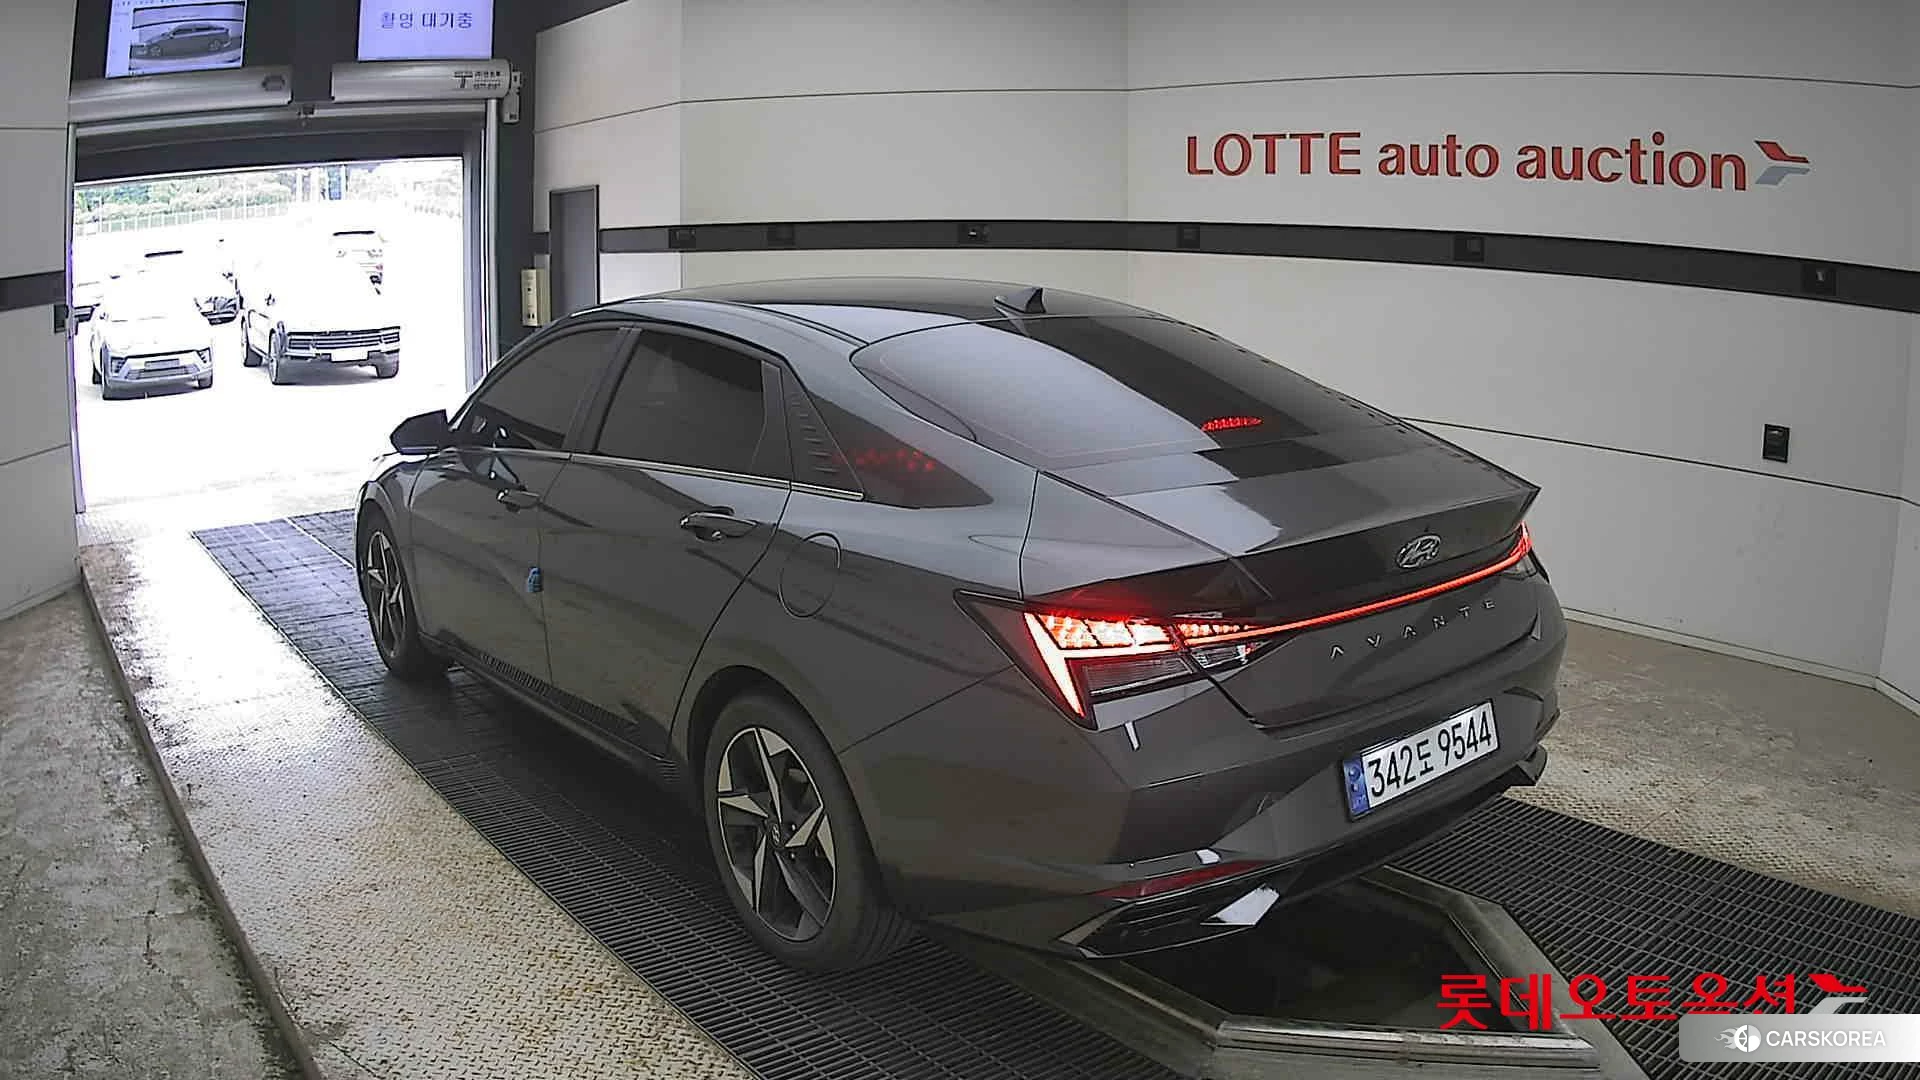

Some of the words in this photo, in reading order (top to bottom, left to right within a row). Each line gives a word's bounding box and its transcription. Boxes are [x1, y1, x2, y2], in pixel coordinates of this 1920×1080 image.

[422, 12, 472, 29] 대기중
[1186, 131, 1362, 176] LOTTE
[1377, 134, 1500, 178] auto
[1516, 131, 1747, 191] auction
[1329, 599, 1496, 660] AVANTE
[1367, 739, 1435, 798] 342도
[1437, 711, 1493, 767] 9544
